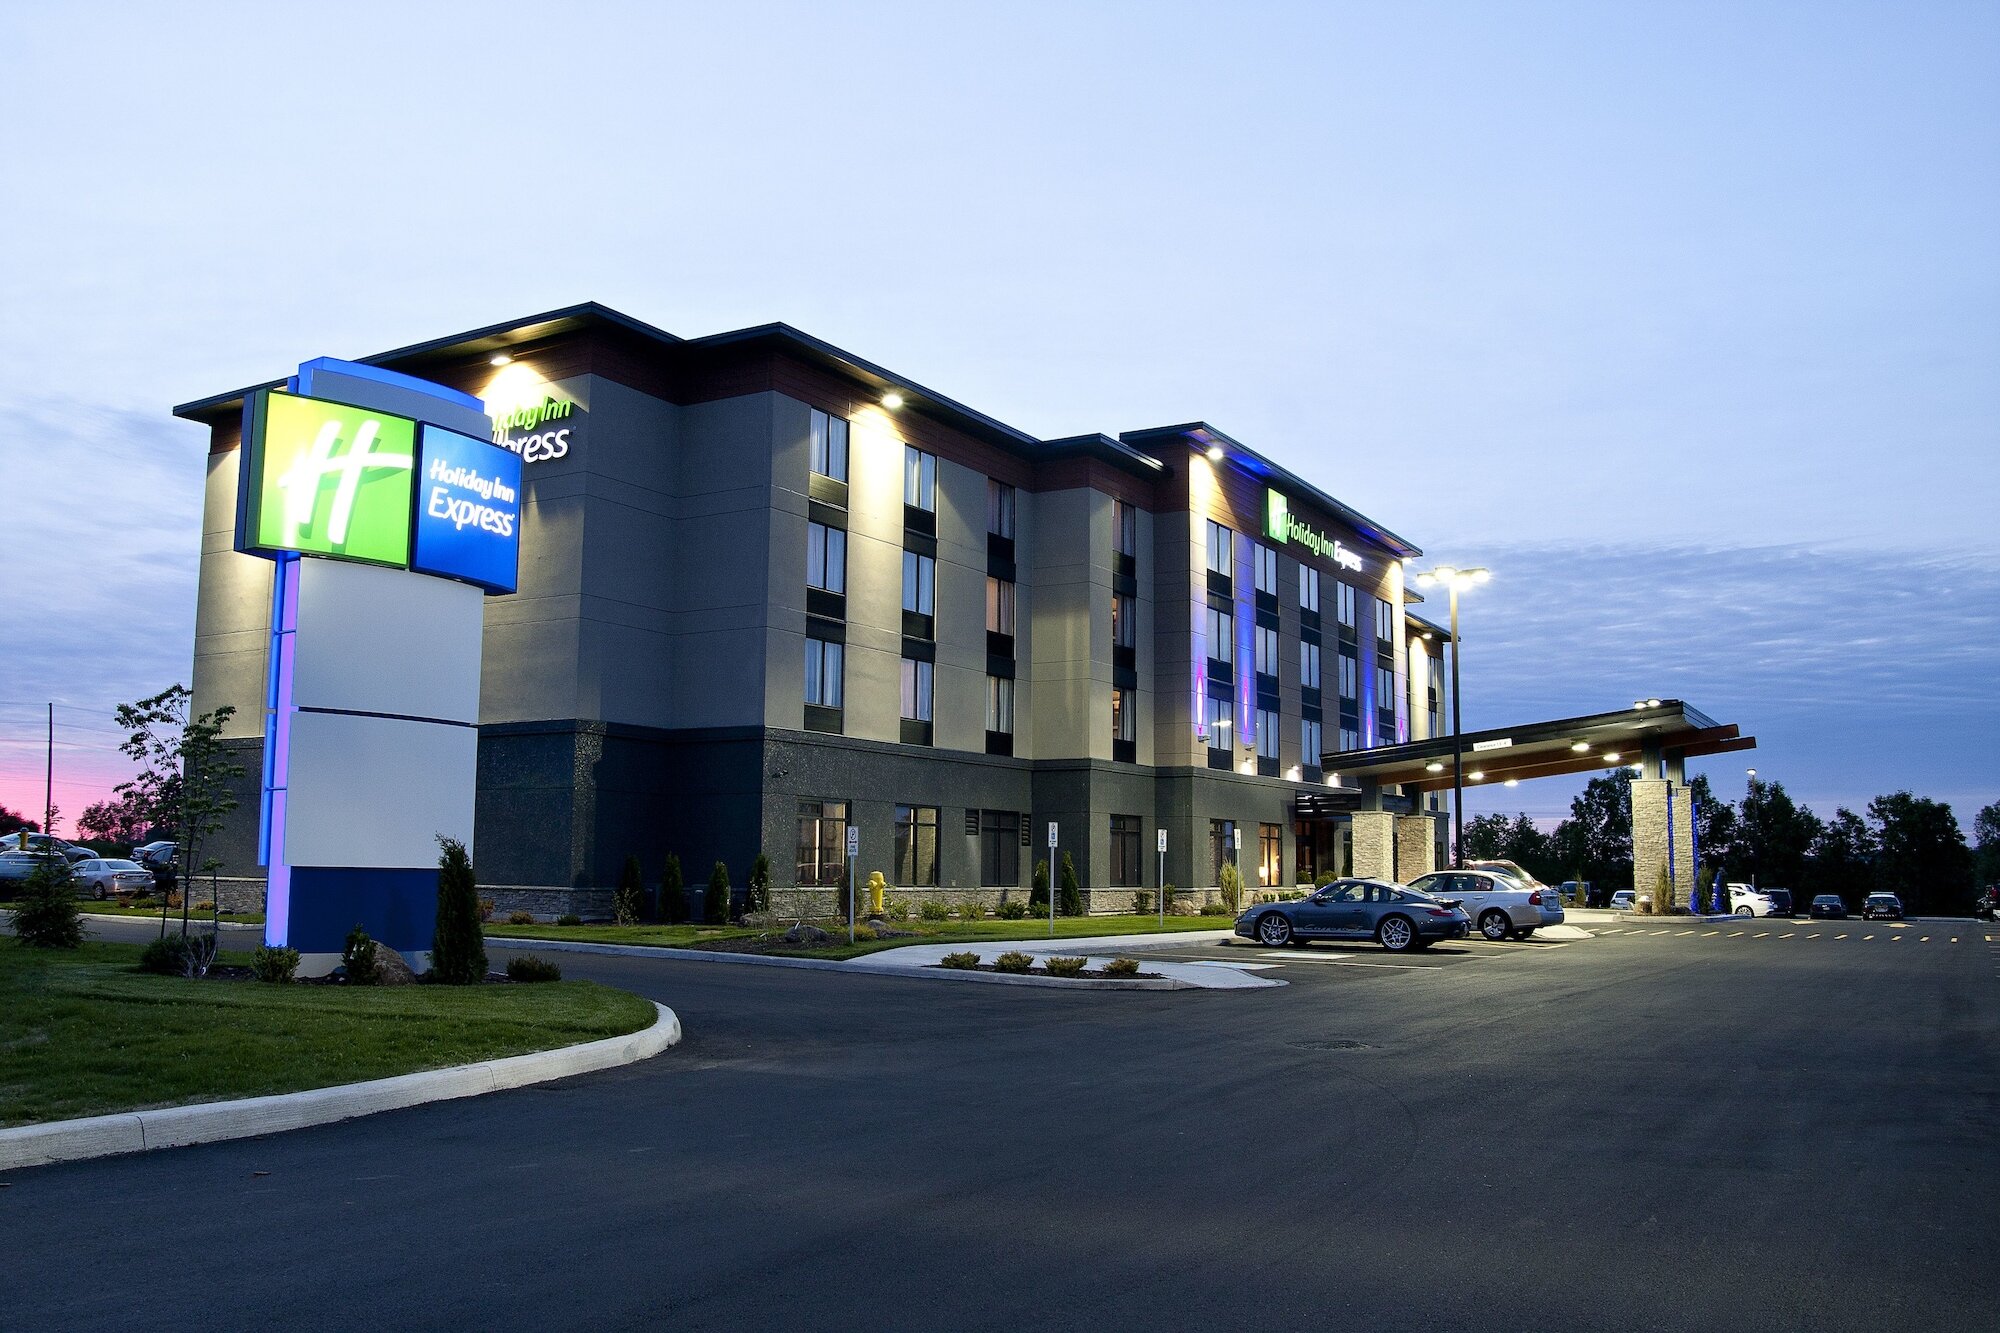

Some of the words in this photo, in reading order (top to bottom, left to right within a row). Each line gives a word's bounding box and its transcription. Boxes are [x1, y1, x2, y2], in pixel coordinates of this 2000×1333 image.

[541, 395, 571, 421] Inn
[430, 458, 493, 499] Holiday
[493, 476, 515, 503] Inn
[428, 486, 514, 536] Express
[1287, 513, 1320, 556] Holiday
[1320, 531, 1334, 558] Inn
